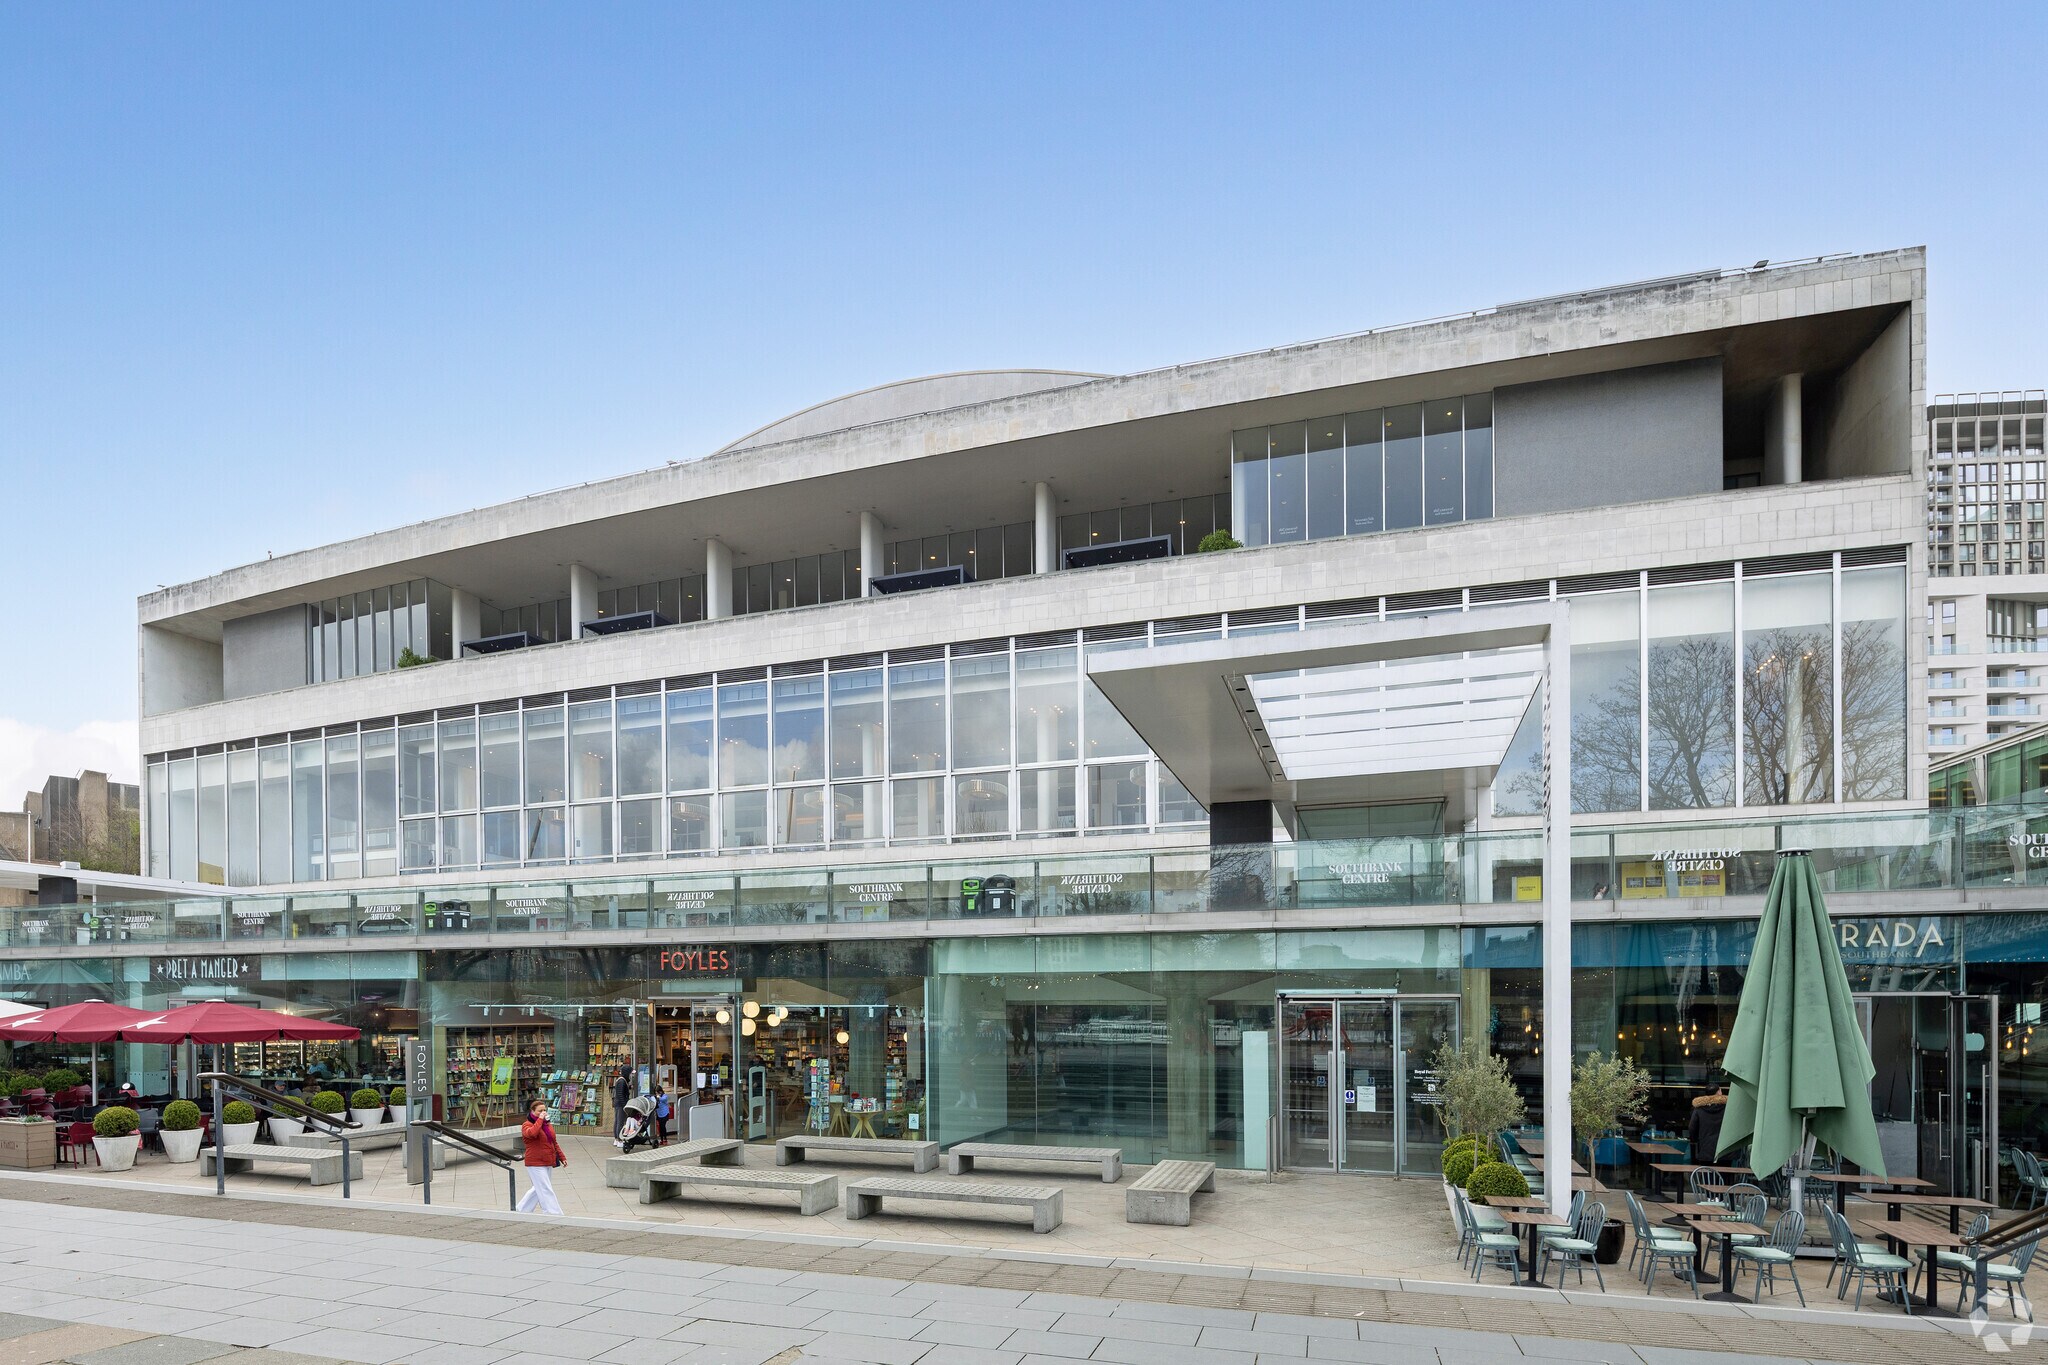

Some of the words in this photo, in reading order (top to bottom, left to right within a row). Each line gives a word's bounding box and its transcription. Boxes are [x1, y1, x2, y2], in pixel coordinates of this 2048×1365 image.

[1328, 861, 1402, 875] SOUTHBANK
[1342, 872, 1390, 884] CENTRE
[849, 882, 903, 894] SOUTHBANK
[859, 892, 894, 902] CENTRE
[505, 898, 548, 908] SOUTHBANK
[237, 911, 271, 919] SOUTHBANK
[513, 906, 541, 915] CENTRE
[243, 917, 265, 925] CENTRE
[660, 949, 729, 971] FOYLES
[1840, 950, 1912, 960] SOUTHBANK
[166, 958, 188, 979] PRET
[191, 959, 198, 979] A
[200, 957, 239, 979] MANGER
[416, 1044, 427, 1092] FOYLES
